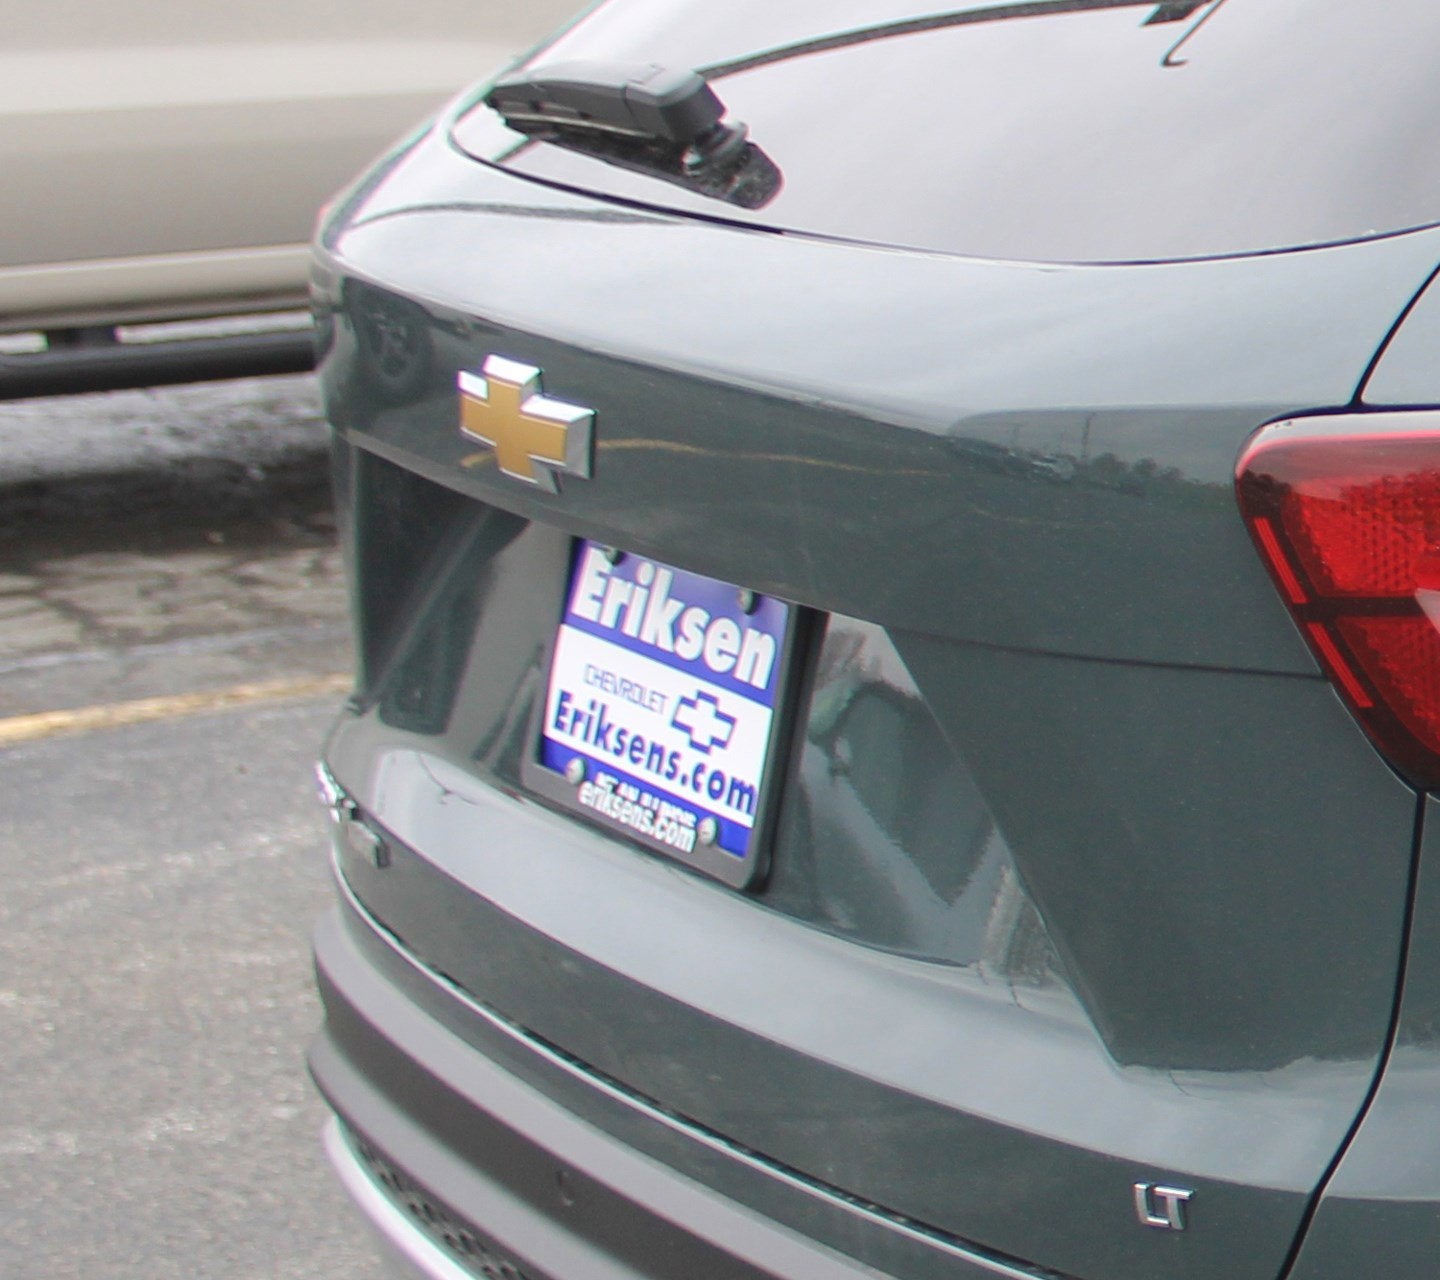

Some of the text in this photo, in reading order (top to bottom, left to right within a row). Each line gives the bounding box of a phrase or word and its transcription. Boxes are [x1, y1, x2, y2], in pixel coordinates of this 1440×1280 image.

[572, 547, 775, 689] Eriksen
[584, 664, 669, 715] CHEVROLET
[554, 690, 755, 814] Eriksens.com
[577, 780, 699, 853] eriksens.com
[1132, 1182, 1195, 1231] LT
